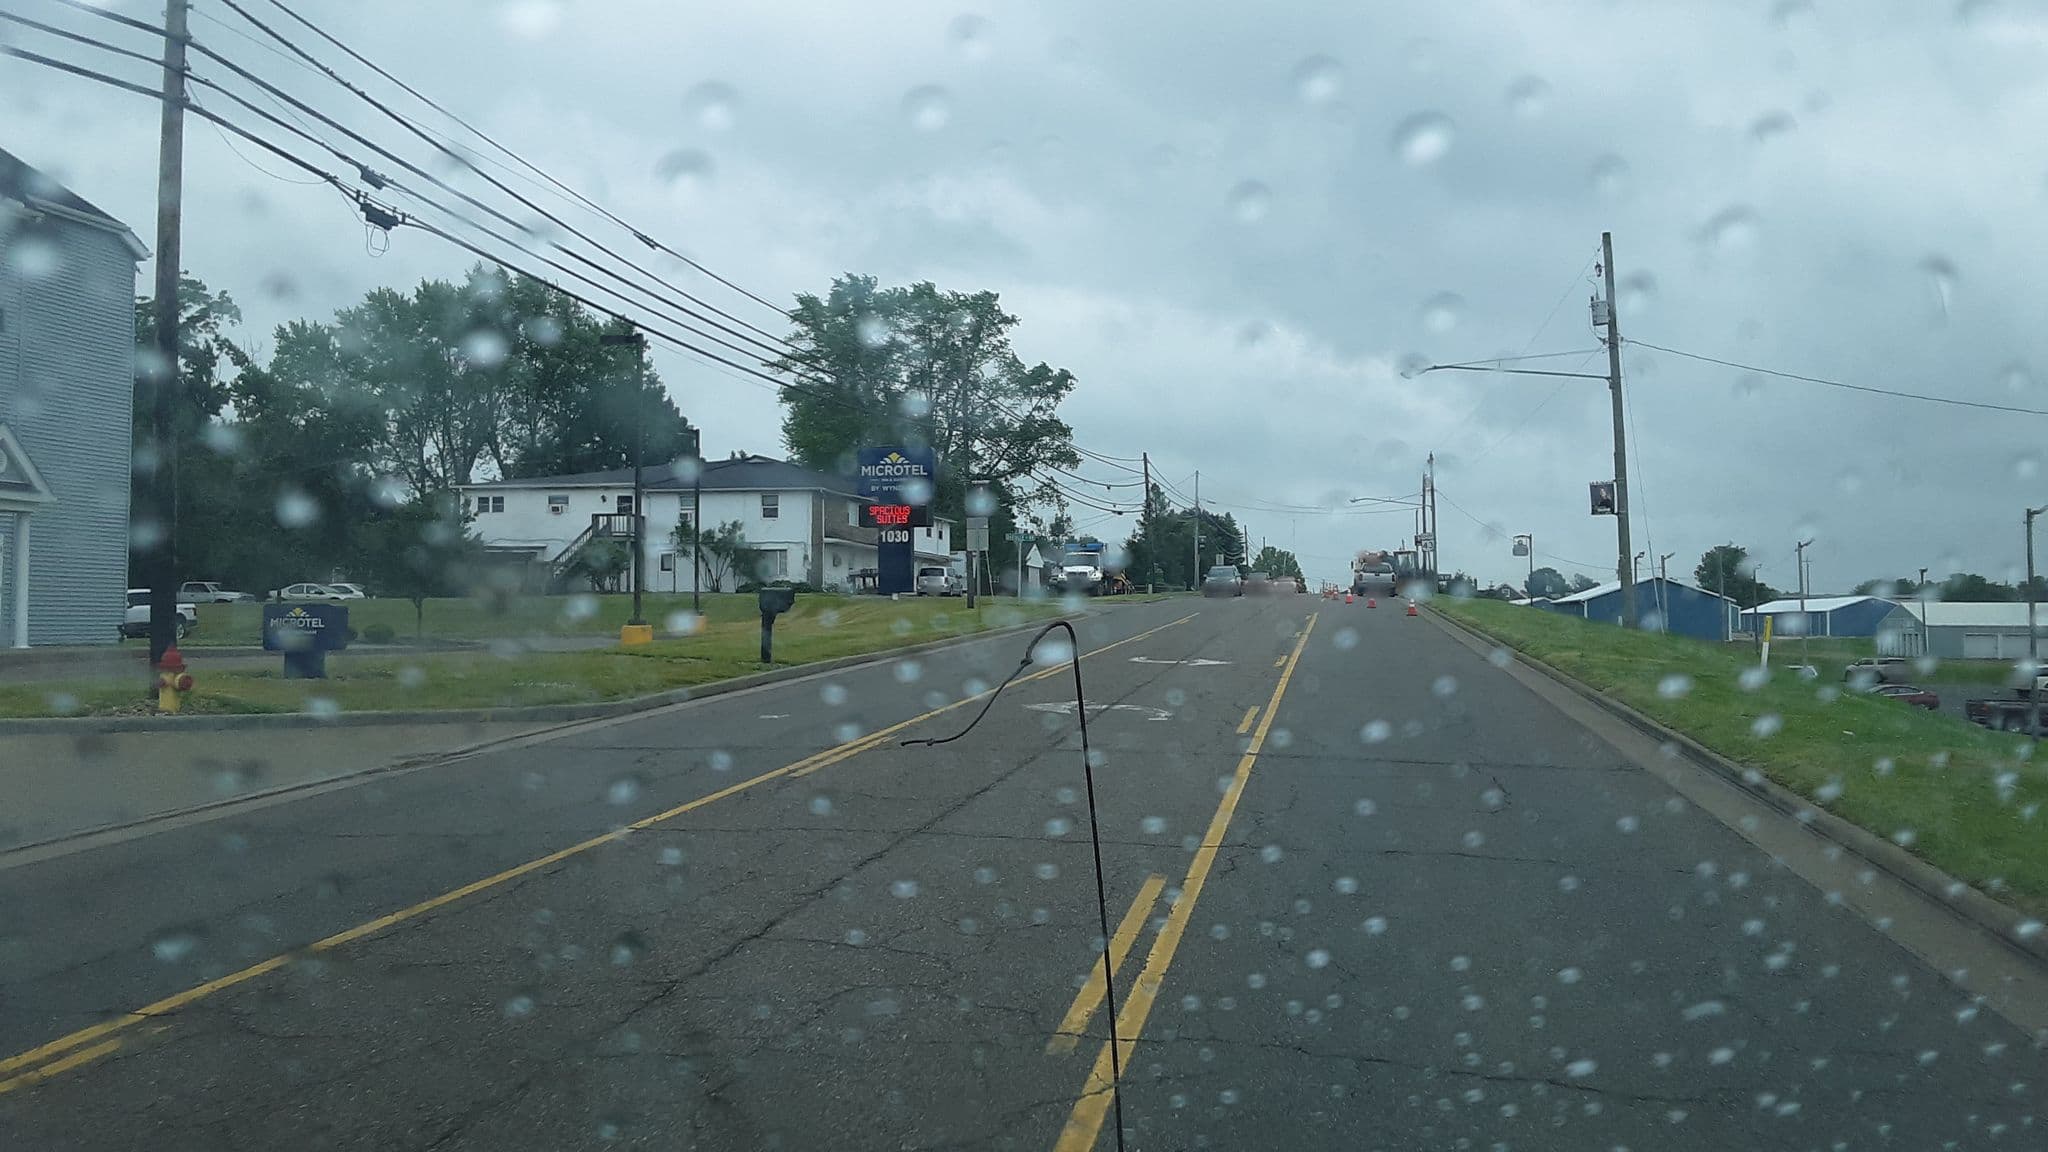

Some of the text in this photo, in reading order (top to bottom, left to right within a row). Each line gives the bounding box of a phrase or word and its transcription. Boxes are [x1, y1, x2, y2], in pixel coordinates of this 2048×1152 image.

[861, 465, 928, 476] MICROTEL
[869, 506, 911, 515] SPACIOUS
[877, 515, 908, 524] SUITES
[881, 530, 909, 543] 1030
[270, 617, 325, 628] MICROTEL
